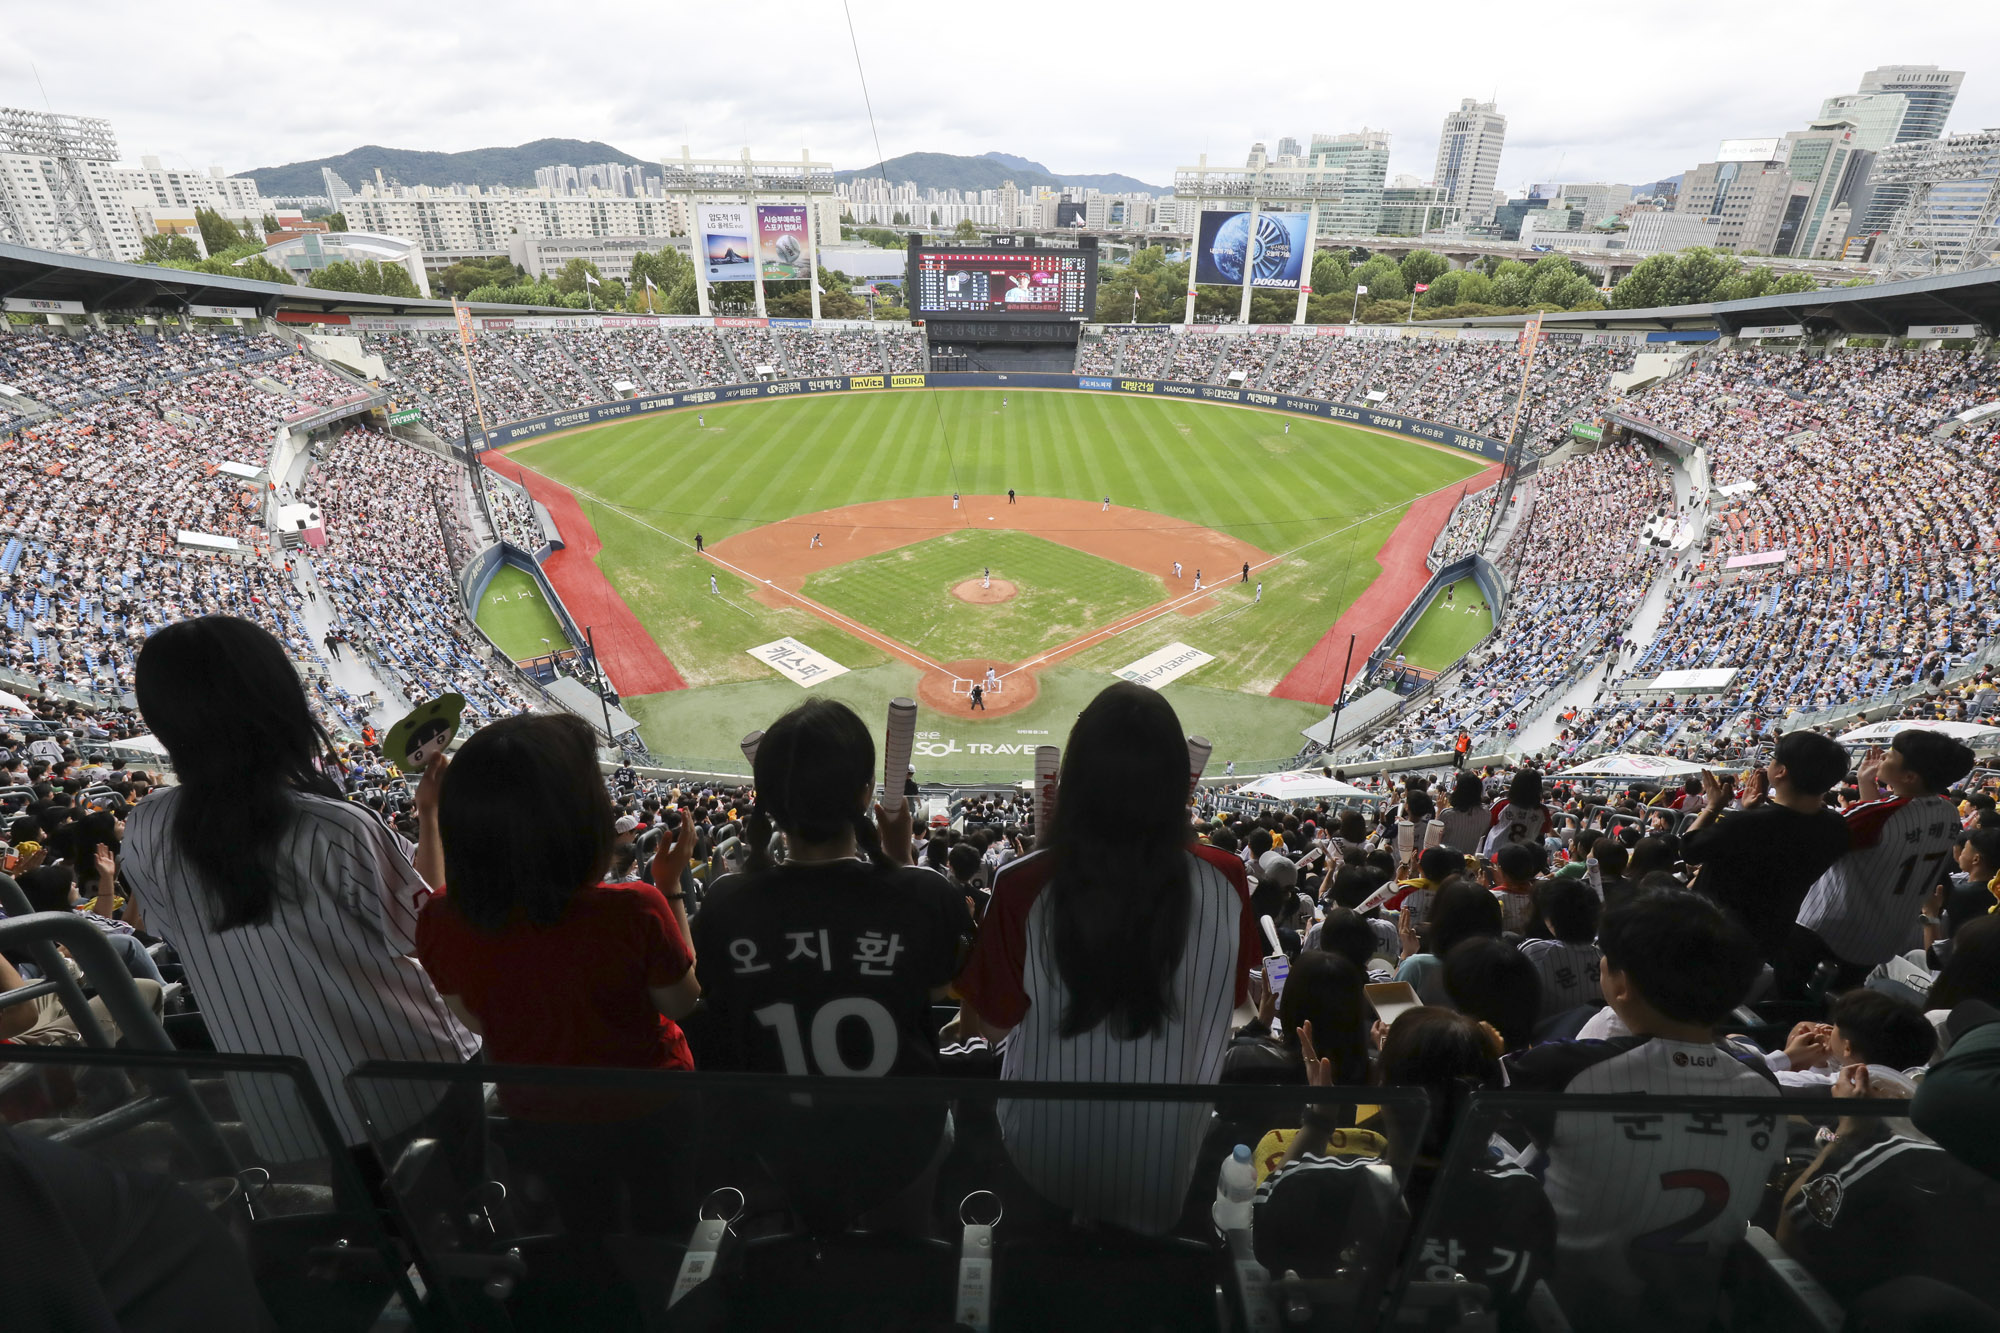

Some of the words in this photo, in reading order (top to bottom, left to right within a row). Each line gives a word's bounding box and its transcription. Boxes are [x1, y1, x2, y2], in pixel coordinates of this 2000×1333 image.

[709, 213, 728, 222] 압도적
[730, 213, 740, 222] 1위
[1252, 278, 1298, 287] DOOSAN
[722, 318, 746, 327] redcap
[932, 324, 1000, 336] 한국경제신문
[1010, 324, 1073, 337] 한국경제TV
[808, 379, 842, 391] 현대해상
[892, 377, 924, 386] UBORA
[1121, 380, 1154, 392] 대방건설
[778, 382, 801, 394] 금강주택
[1164, 385, 1195, 395] HANCOM
[1214, 389, 1240, 400] 대보건설
[1286, 400, 1319, 412] 한국경제TV
[1422, 427, 1432, 436] KB
[1454, 434, 1484, 452] 키움증권
[914, 739, 962, 757] SOL
[967, 744, 1036, 754] TRAVE
[1509, 823, 1527, 843] 8
[1893, 851, 1948, 895] 17
[728, 929, 905, 975] 오지환
[1555, 961, 1601, 979] 문성
[753, 997, 898, 1078] 10
[1630, 1168, 1731, 1250] 2
[1419, 1237, 1531, 1294] 창기
